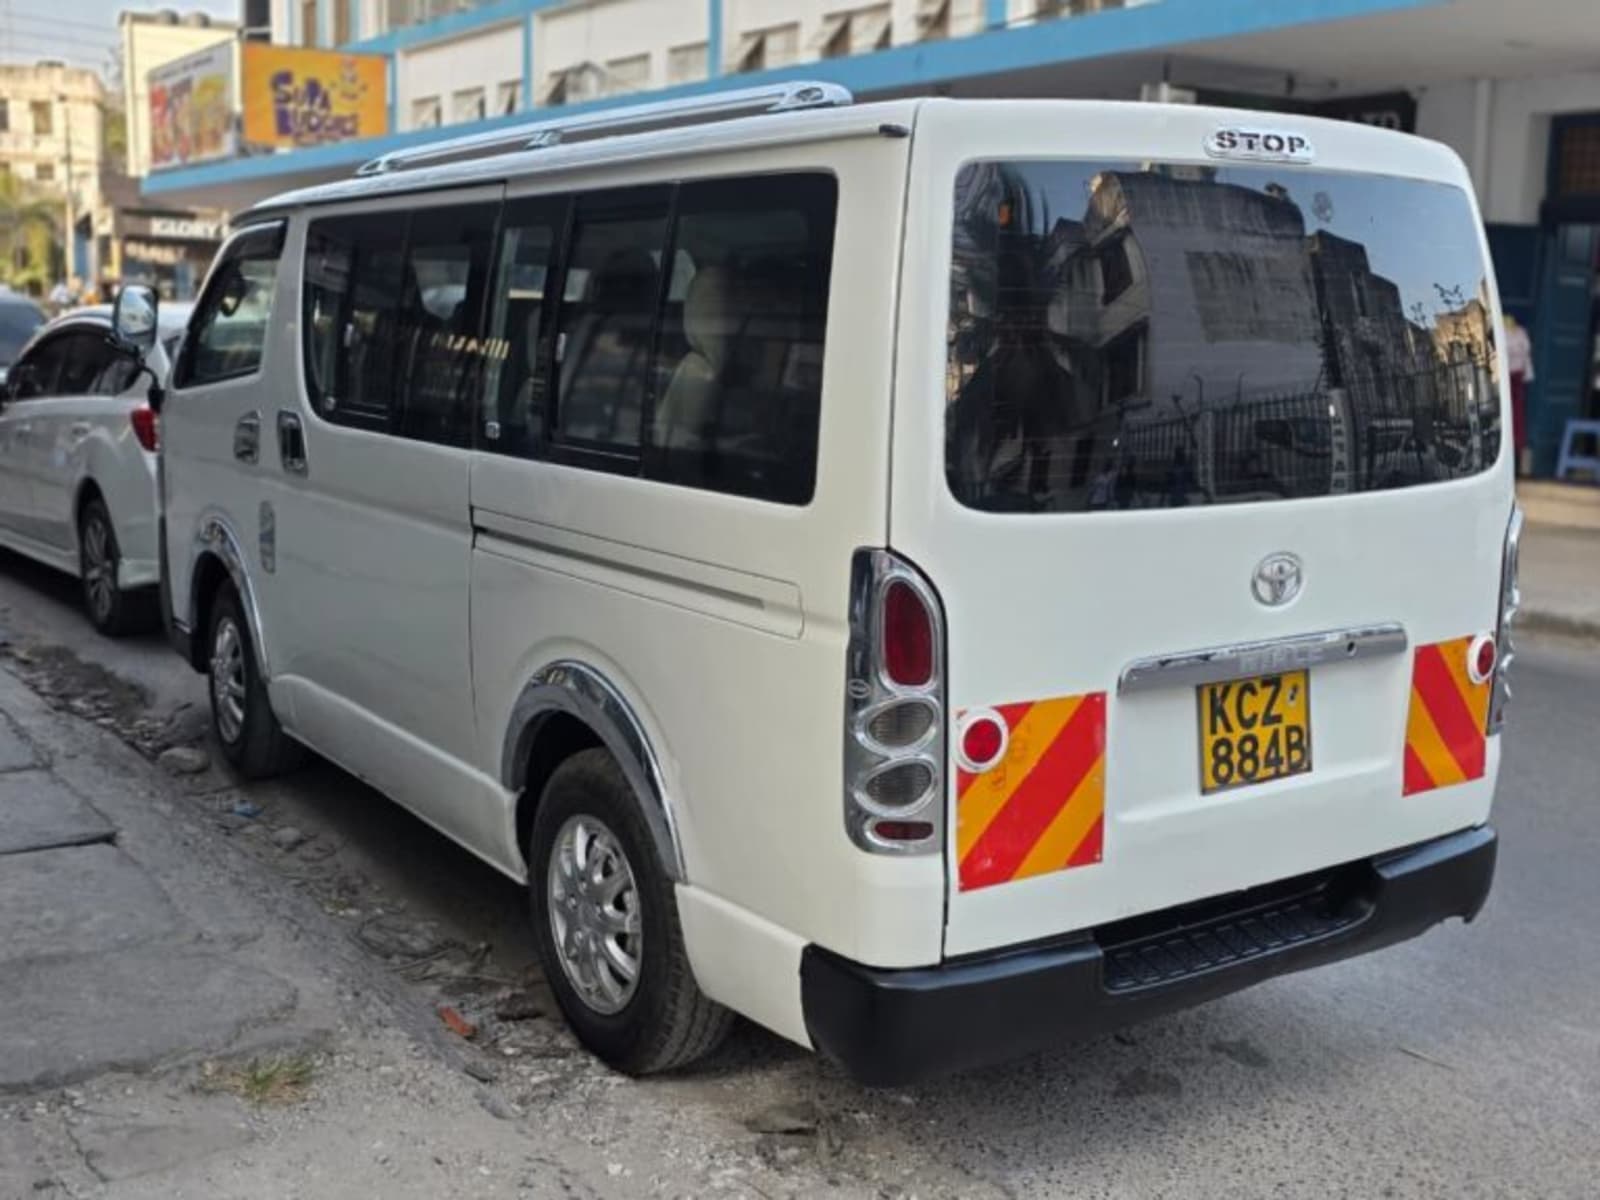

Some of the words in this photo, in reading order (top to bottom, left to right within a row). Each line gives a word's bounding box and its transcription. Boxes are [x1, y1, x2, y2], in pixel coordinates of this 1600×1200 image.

[1215, 130, 1305, 151] STOP
[1209, 676, 1284, 735] KCZ
[1212, 725, 1307, 785] 884B
